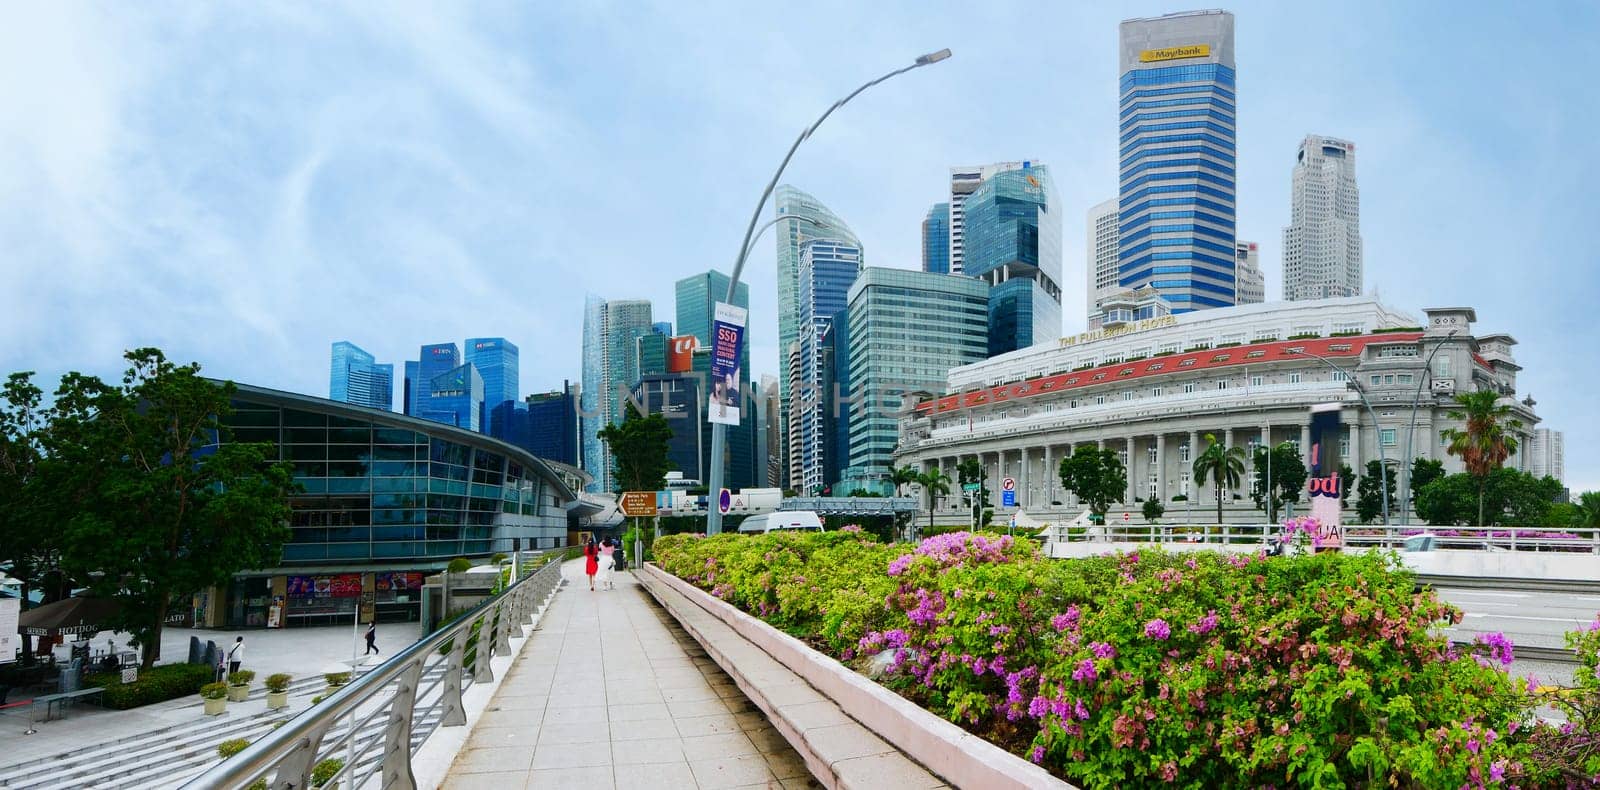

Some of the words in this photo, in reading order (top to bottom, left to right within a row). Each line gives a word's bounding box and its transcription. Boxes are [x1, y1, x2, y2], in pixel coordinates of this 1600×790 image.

[1154, 47, 1201, 58] Maybank
[718, 328, 737, 343] SSO
[1058, 335, 1076, 347] THE
[1079, 323, 1137, 343] FULLERTON
[1140, 315, 1178, 330] HOTEL
[163, 614, 185, 623] LATO
